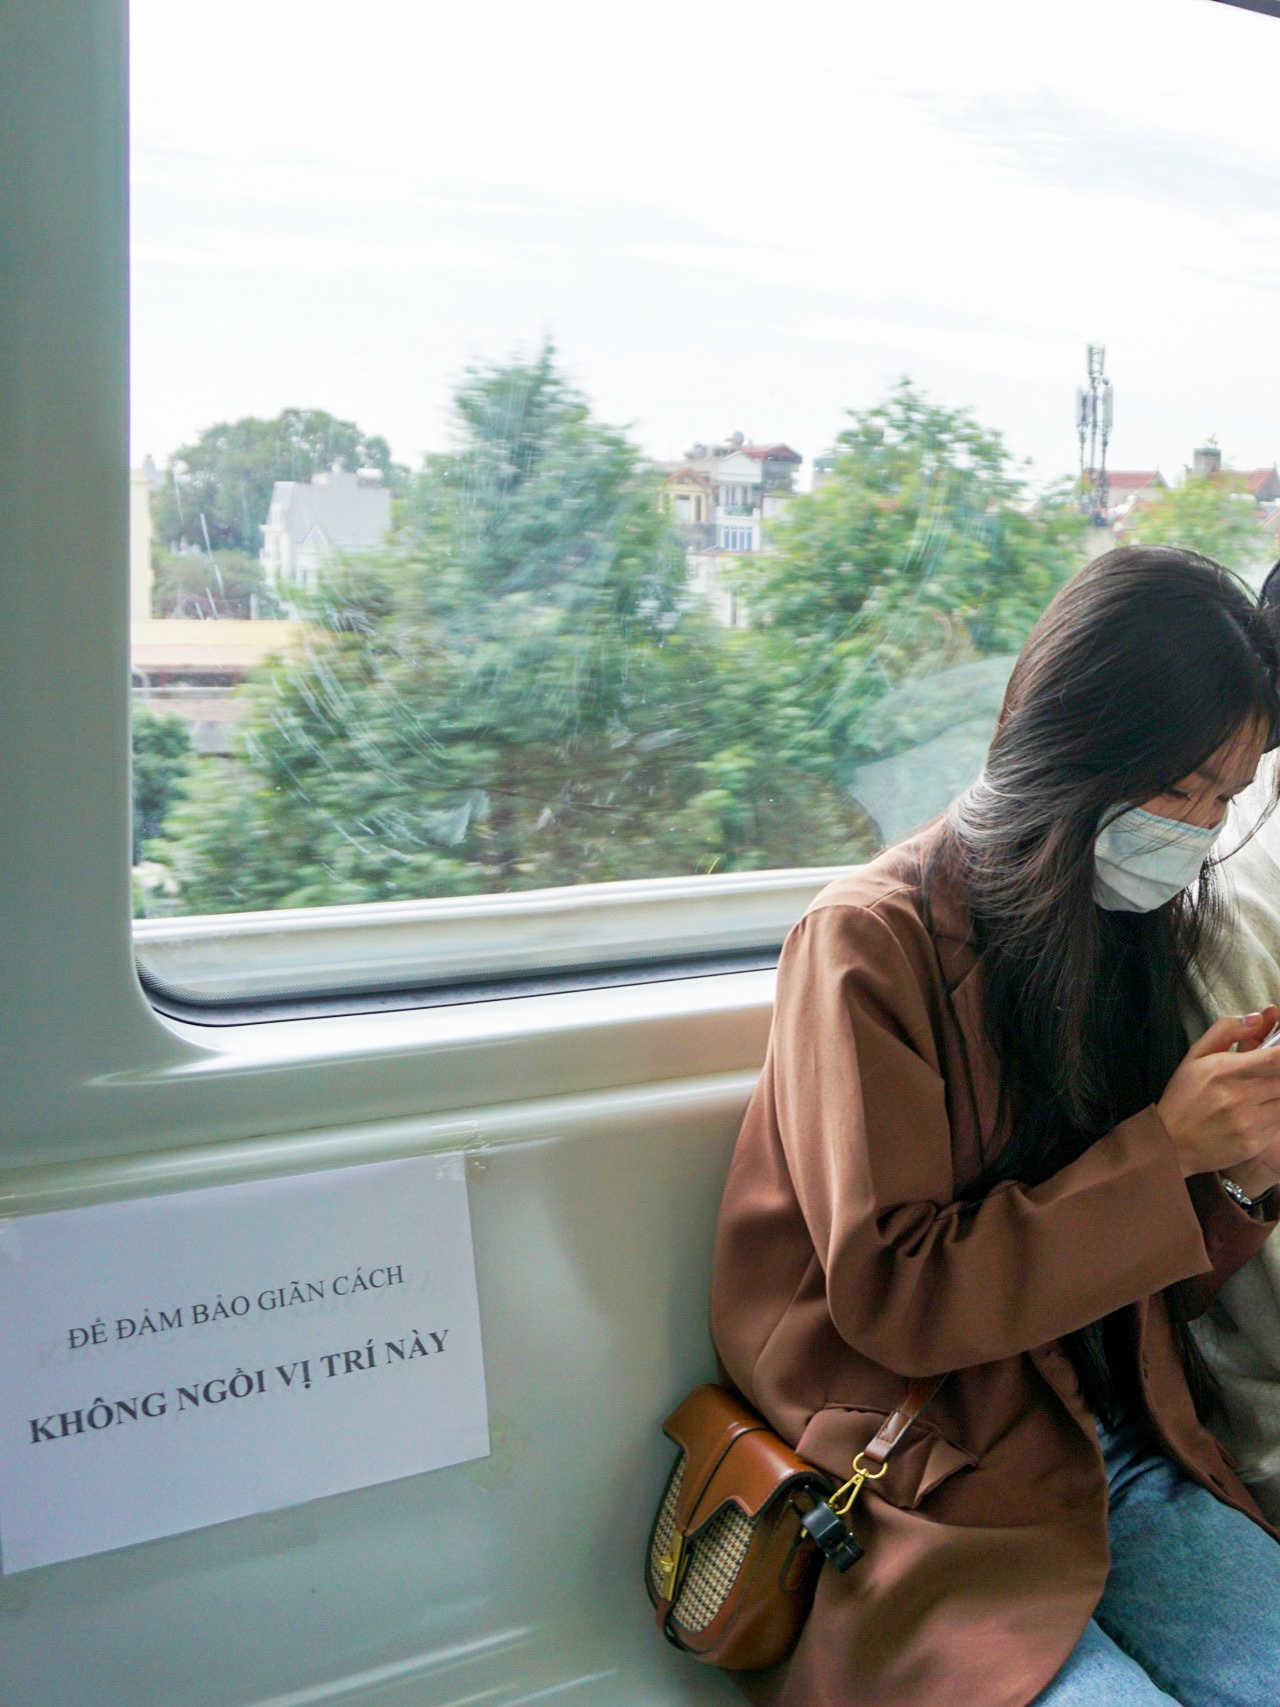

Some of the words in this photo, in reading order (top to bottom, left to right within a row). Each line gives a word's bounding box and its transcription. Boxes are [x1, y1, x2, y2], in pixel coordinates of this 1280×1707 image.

[67, 1317, 108, 1350] ĐỂ
[115, 1307, 184, 1341] ĐẢM
[191, 1294, 251, 1326] BẢO
[257, 1280, 326, 1312] GIÃN
[332, 1264, 405, 1296] CÁCH
[28, 1391, 168, 1445] KHÔNG
[176, 1368, 268, 1412] NGỒI
[275, 1358, 313, 1390] VỊ
[319, 1338, 378, 1379] TRÍ
[384, 1328, 450, 1366] NÀY
